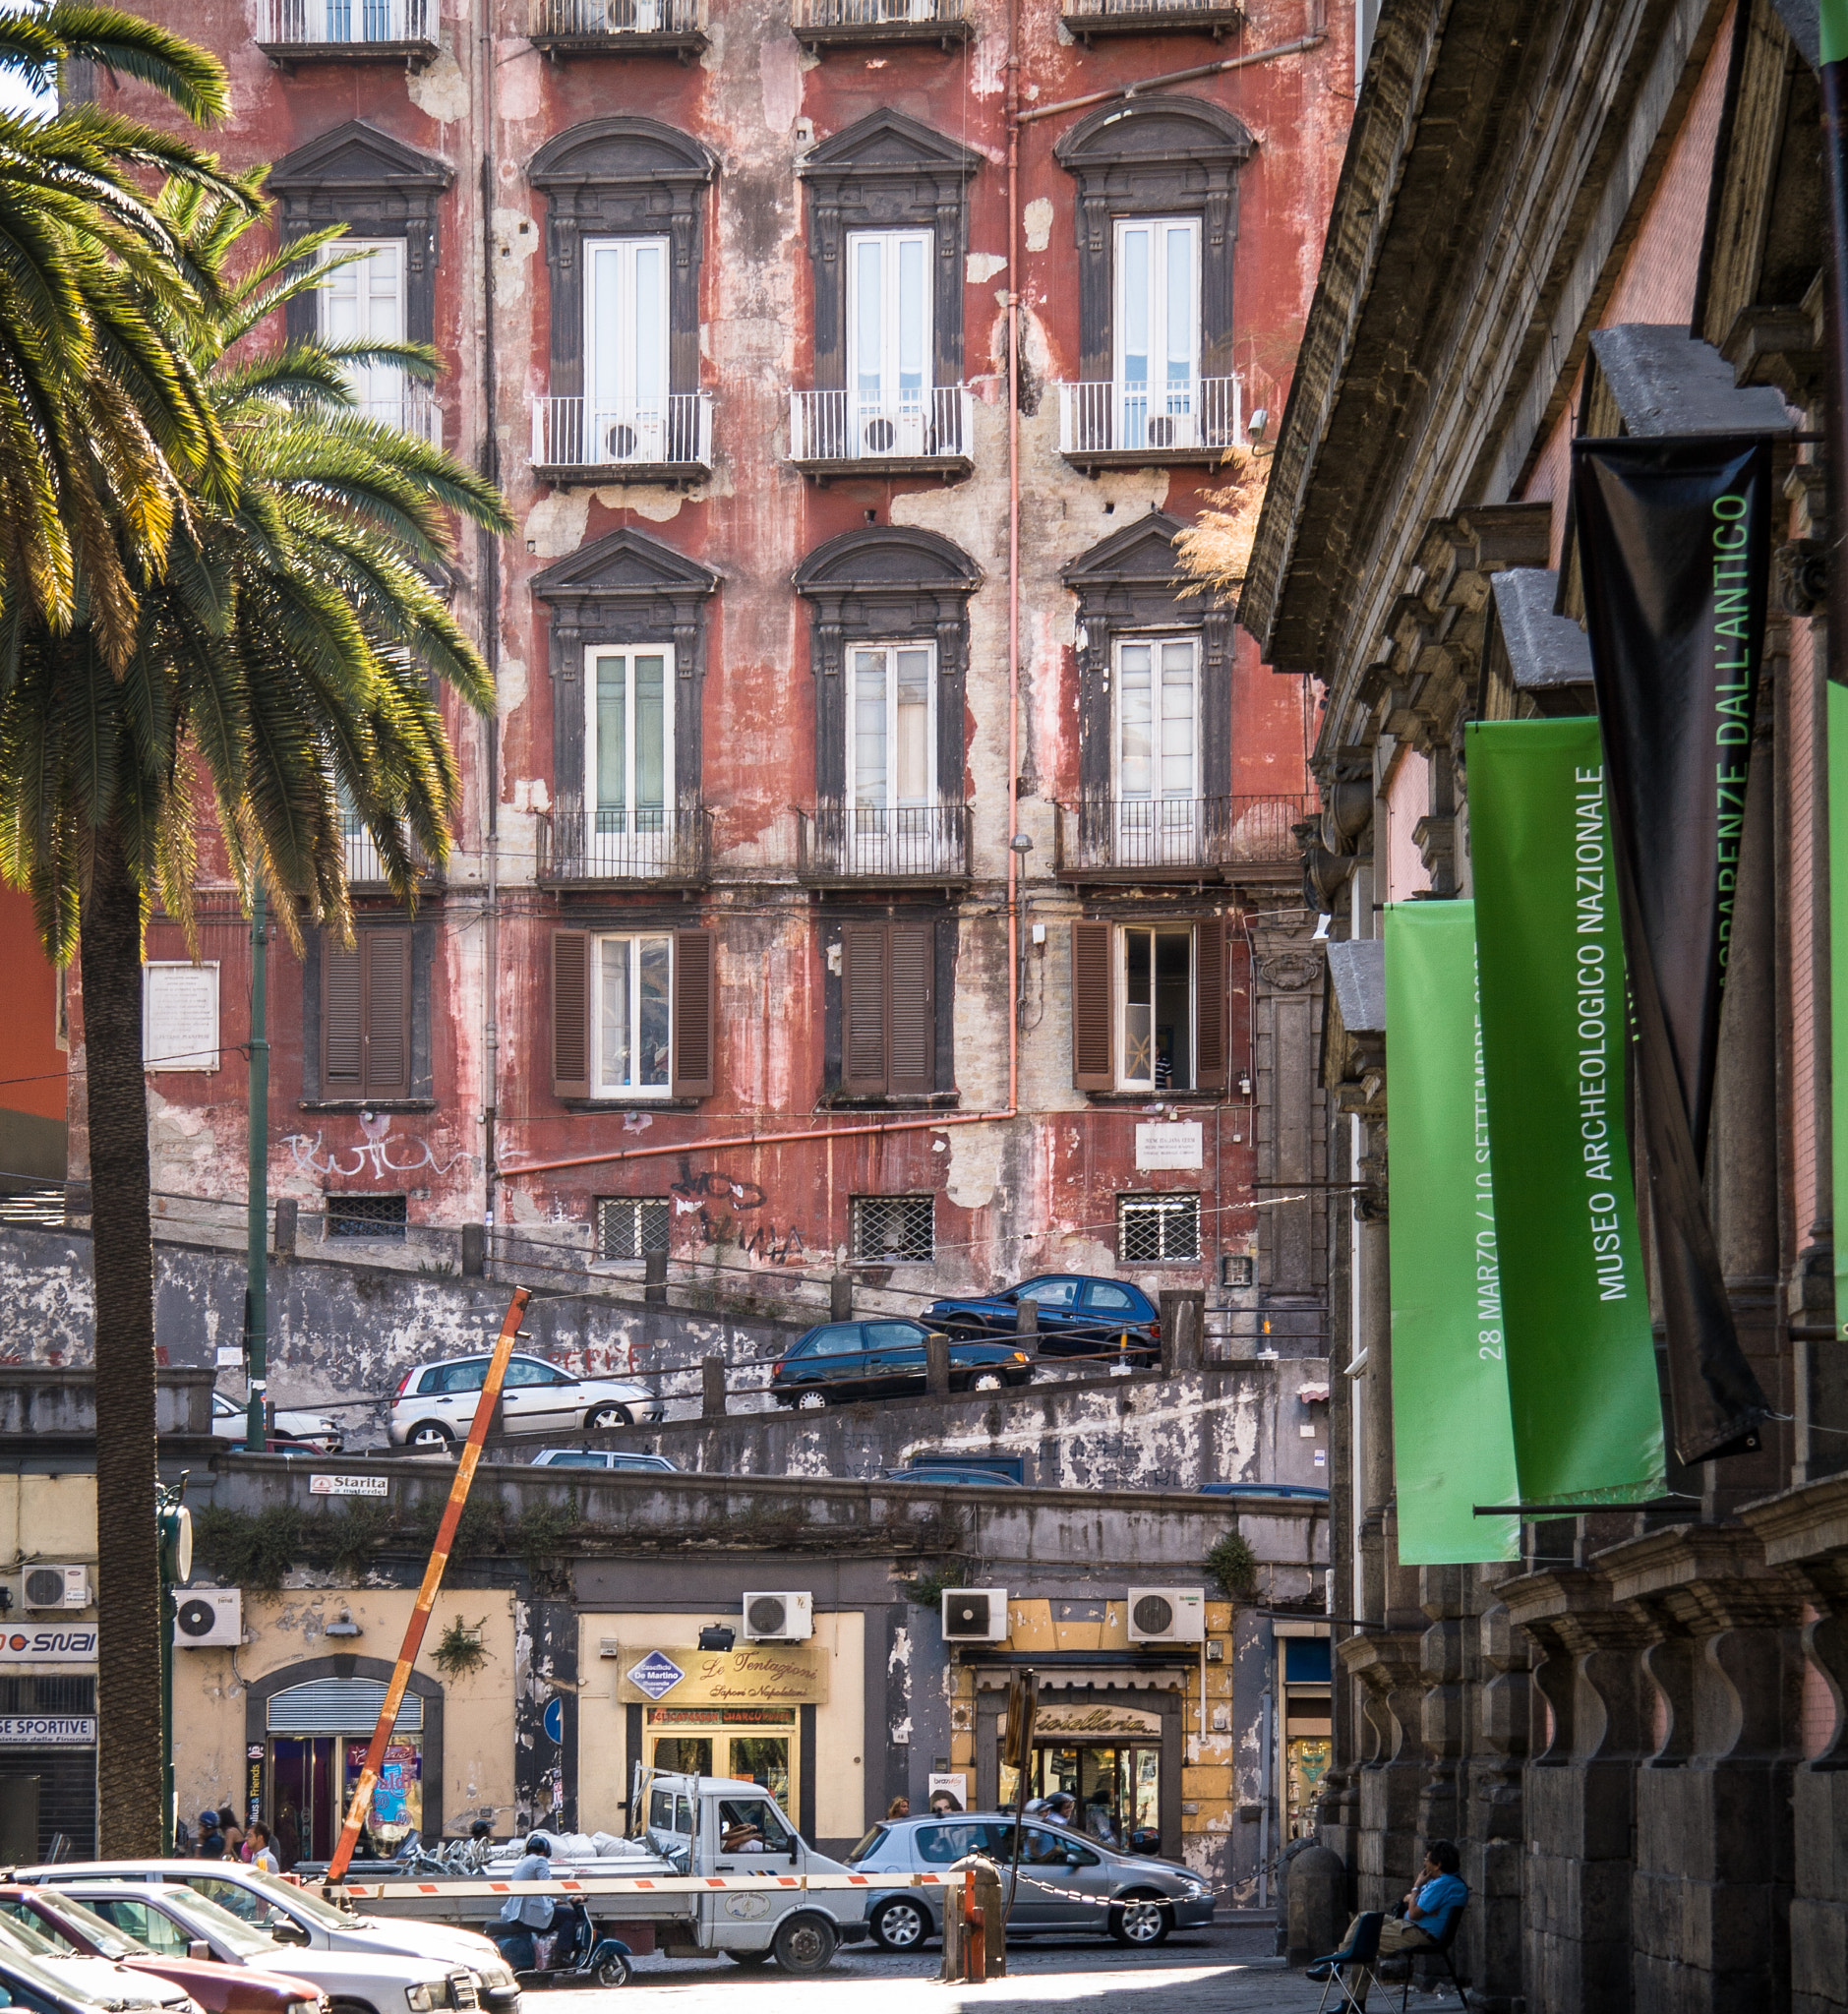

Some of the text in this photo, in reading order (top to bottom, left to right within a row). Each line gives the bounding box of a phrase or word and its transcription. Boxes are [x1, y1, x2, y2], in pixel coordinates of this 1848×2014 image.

[1712, 495, 1750, 745] DALL'ANTICO
[1575, 764, 1628, 1302] MUSEO ARCHEOLOGICO NAZIONALE
[1475, 1172, 1493, 1202] 10
[1476, 1230, 1501, 1320] MARZO
[1477, 1329, 1503, 1361] 28
[333, 1476, 387, 1489] Starita
[647, 1671, 679, 1680] Martino
[699, 1656, 726, 1681] Le
[709, 1684, 747, 1700] Sapori
[16, 1720, 89, 1734] SPORTIVE
[1036, 1708, 1146, 1733] ioielleria
[250, 1763, 262, 1798] Friends
[374, 1772, 413, 1791] aldi
